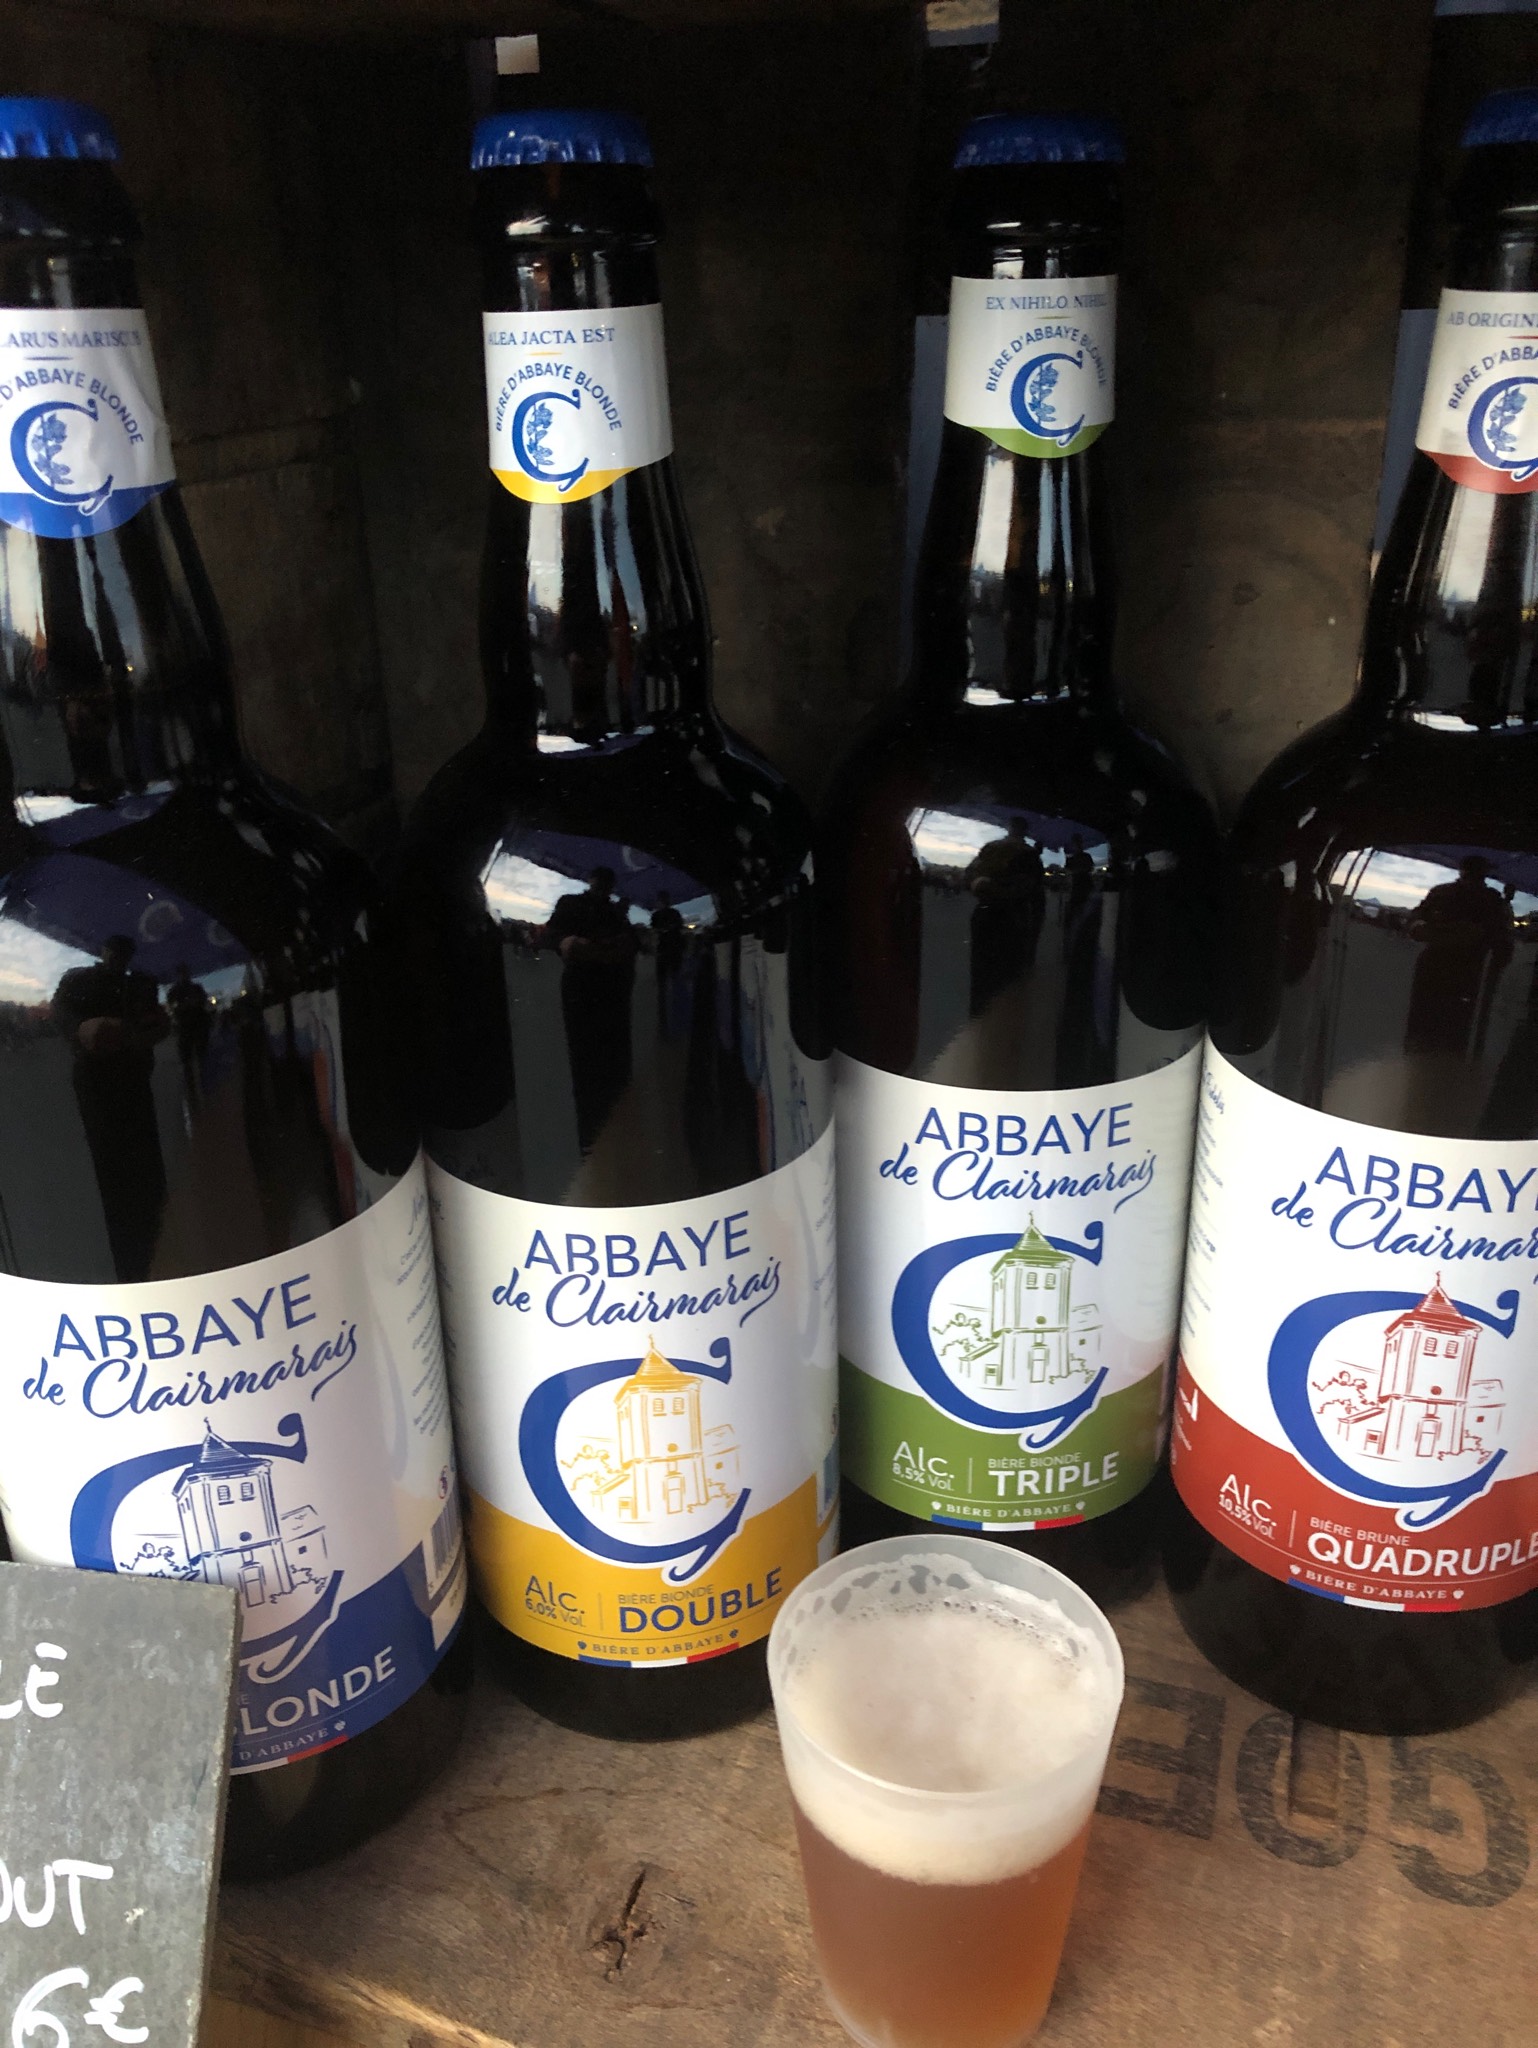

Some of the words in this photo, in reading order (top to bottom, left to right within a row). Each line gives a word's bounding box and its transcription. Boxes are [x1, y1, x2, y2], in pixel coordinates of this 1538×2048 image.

[985, 296, 1006, 310] EX
[1010, 295, 1068, 310] NIHILO
[1447, 311, 1464, 326] AB
[1467, 312, 1538, 329] ORIGIN
[0, 331, 59, 348] ARUS
[521, 329, 577, 346] JACTA
[582, 328, 616, 344] EST
[986, 350, 1013, 392] BIÈRE
[1010, 326, 1080, 354] D'ABBAYE
[507, 362, 574, 392] D'ABBAYE
[573, 371, 622, 431] BLONDE
[1447, 366, 1481, 410] BIÈRE
[89, 378, 145, 446] BLONDE
[915, 1103, 1133, 1156] ABBAYE
[879, 1141, 919, 1186] de
[932, 1148, 1158, 1215] Clairmarais
[1270, 1181, 1315, 1228] de
[524, 1210, 752, 1279] ABBAYE
[491, 1267, 531, 1313] de
[546, 1255, 782, 1328] Clairmarais
[52, 1274, 318, 1363] ABBAYE
[22, 1357, 67, 1405] de
[83, 1319, 358, 1419] Clairmarais
[892, 1441, 955, 1479] Alc.
[988, 1456, 1025, 1469] BIÈRE
[988, 1450, 1120, 1496] TRIPLE
[946, 1503, 992, 1518] BIÈRE
[997, 1503, 1072, 1518] D'ABBAYE
[1219, 1473, 1277, 1527] Alc.
[1307, 1531, 1538, 1577] QUADRUPLE
[1309, 1516, 1352, 1538] BIÈRE
[1356, 1530, 1411, 1547] BRUNE
[525, 1575, 586, 1615] Alc.
[618, 1593, 656, 1605] BIÈRE
[619, 1566, 783, 1633] DOUBLE
[1305, 1569, 1357, 1591] BIÈRE
[1363, 1585, 1448, 1600] D'ABBAYE
[592, 1643, 639, 1656] BIÈRE
[646, 1633, 724, 1655] D'ABBAYE
[232, 1645, 396, 1737] LONDE
